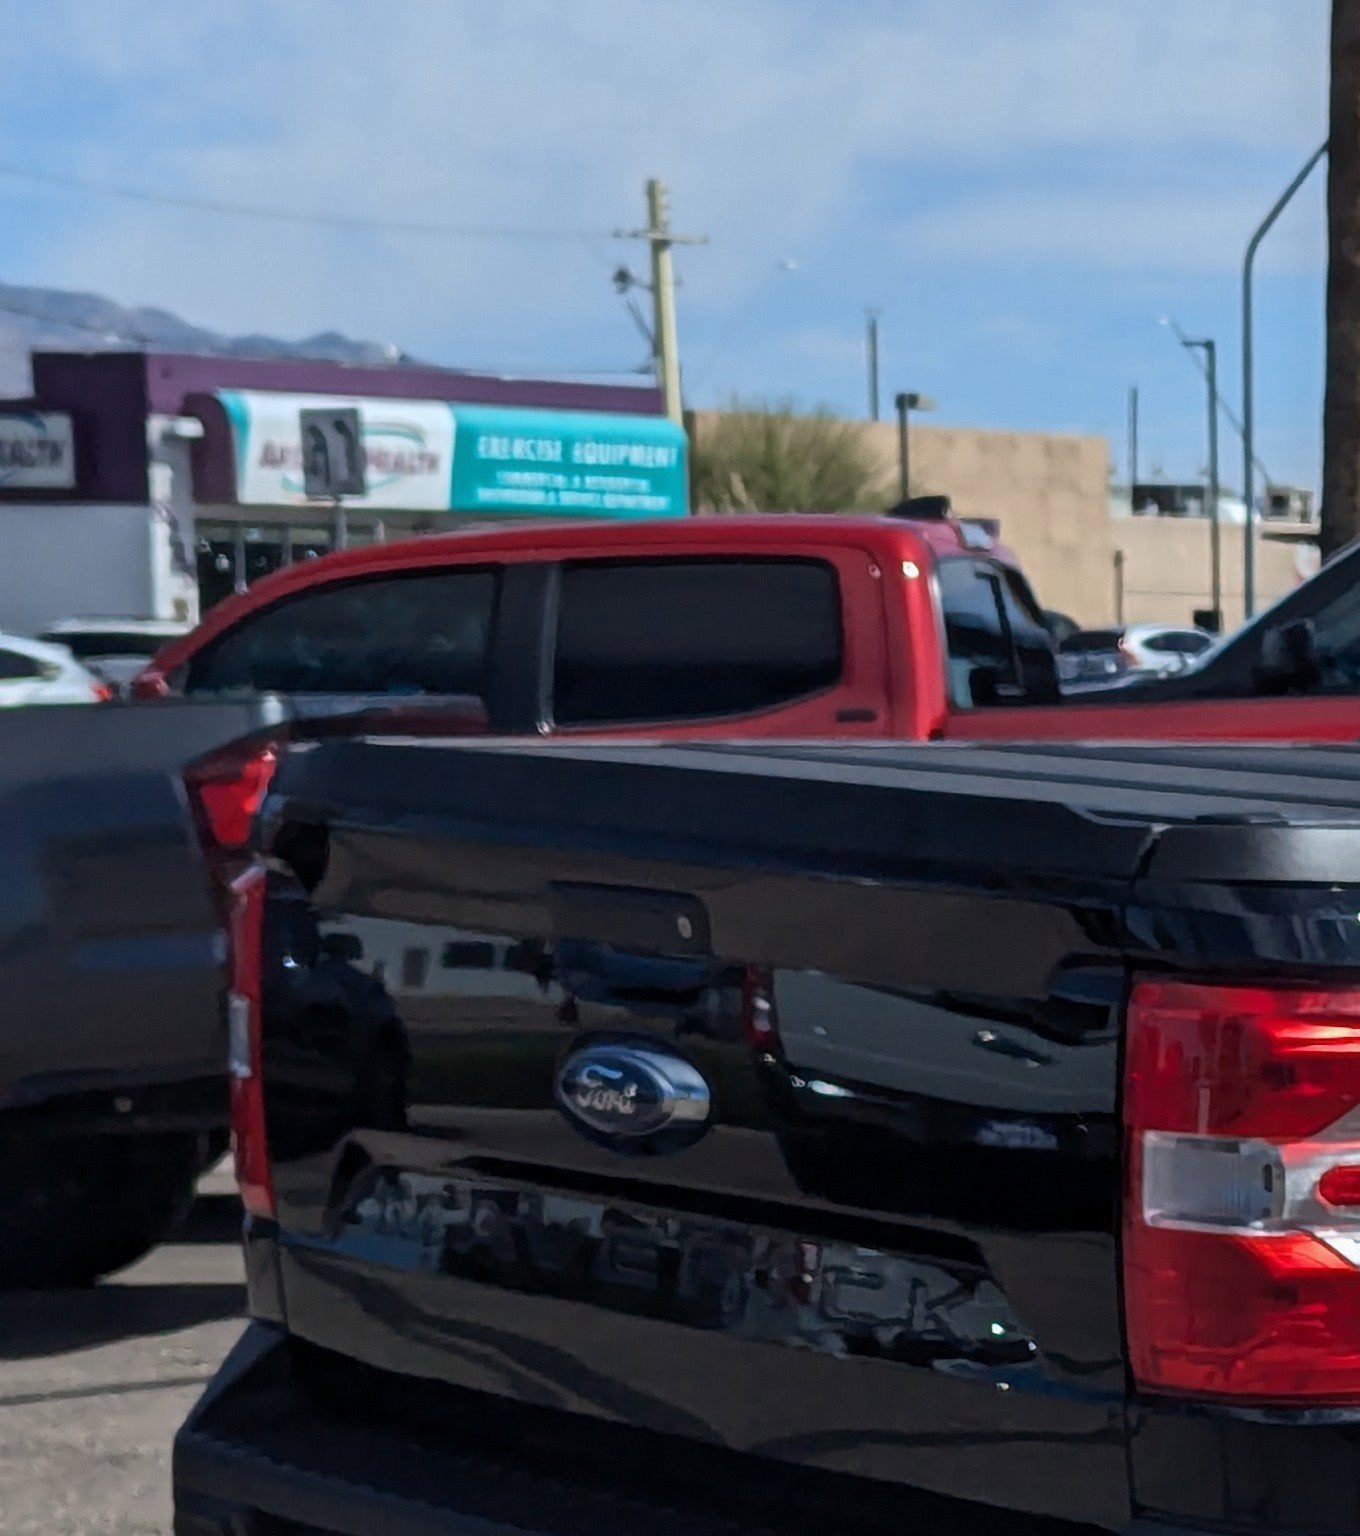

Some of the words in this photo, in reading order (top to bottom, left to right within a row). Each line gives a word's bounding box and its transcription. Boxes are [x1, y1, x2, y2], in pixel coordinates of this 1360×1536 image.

[478, 436, 562, 462] EXERCISE
[572, 441, 678, 467] EQUIPMENT
[576, 1064, 638, 1114] Ford
